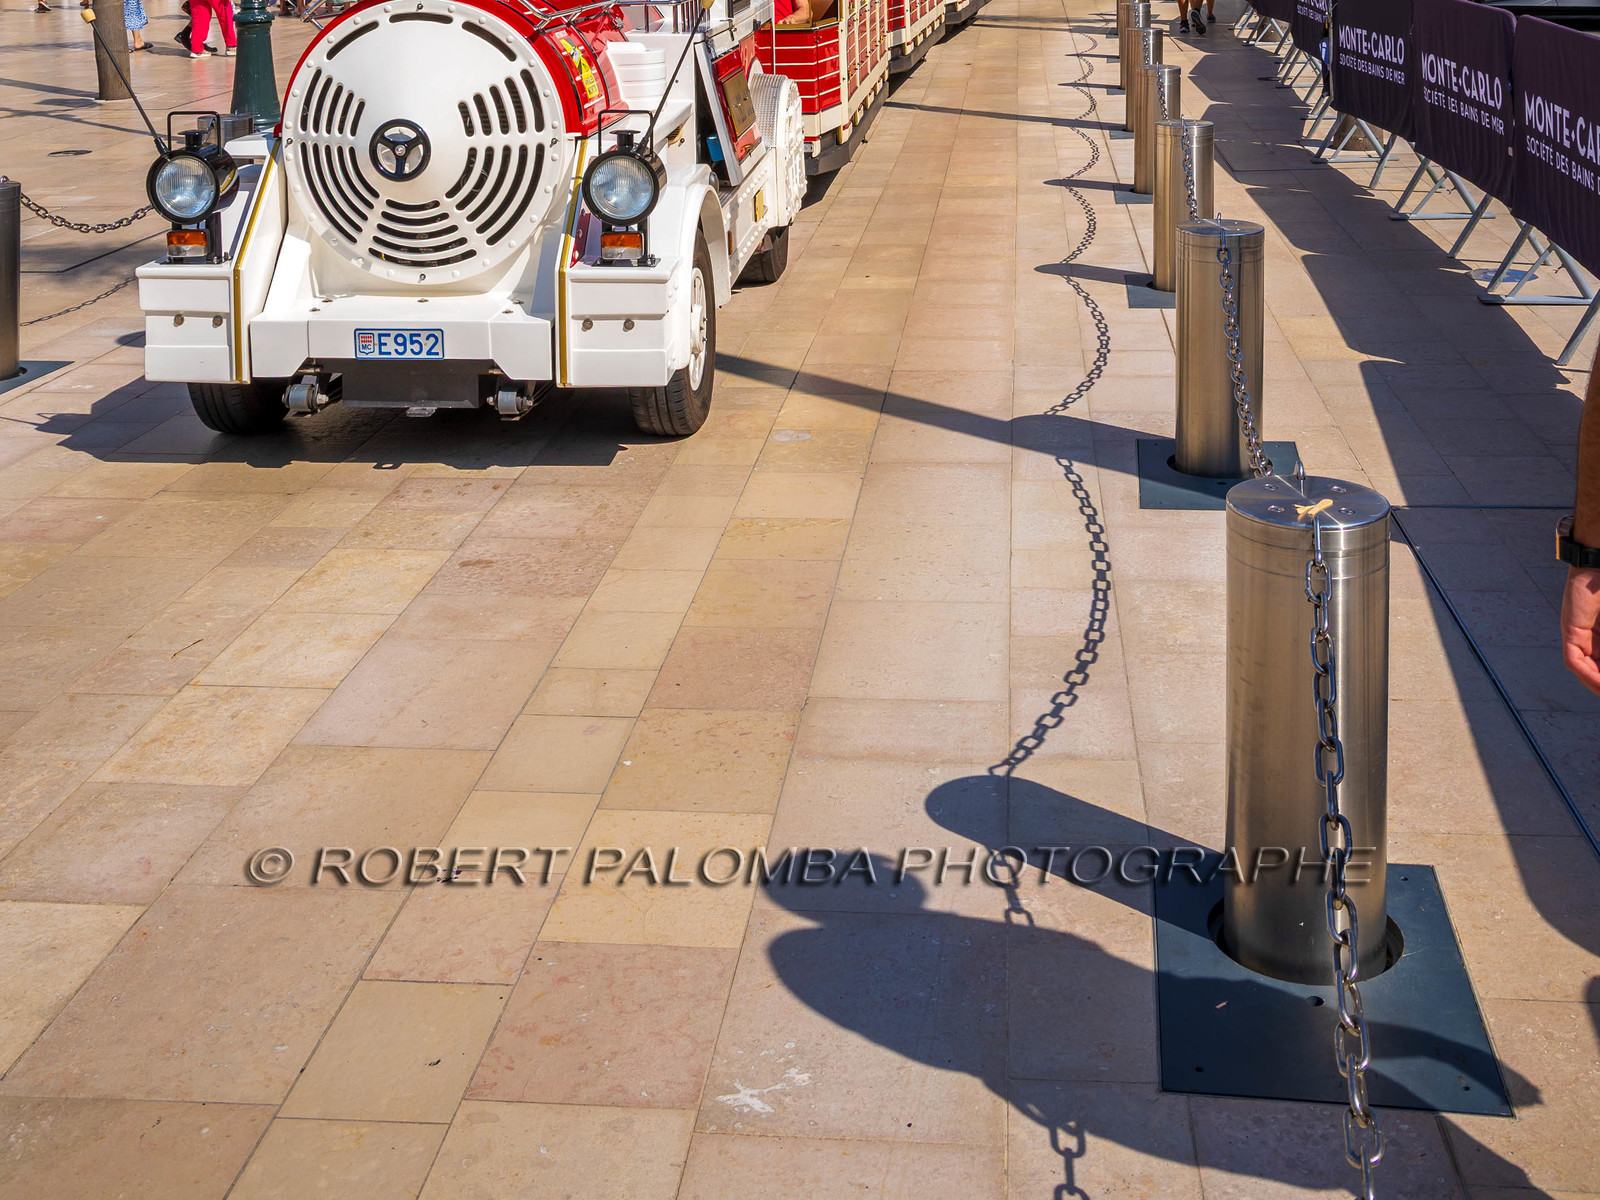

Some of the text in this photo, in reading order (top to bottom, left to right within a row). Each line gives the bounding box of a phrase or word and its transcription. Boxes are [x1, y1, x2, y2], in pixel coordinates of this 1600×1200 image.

[1385, 67, 1393, 81] DE
[1480, 110, 1491, 128] DE
[1556, 151, 1569, 175] DES
[1571, 160, 1595, 191] BAINS
[361, 332, 440, 356] MC E952
